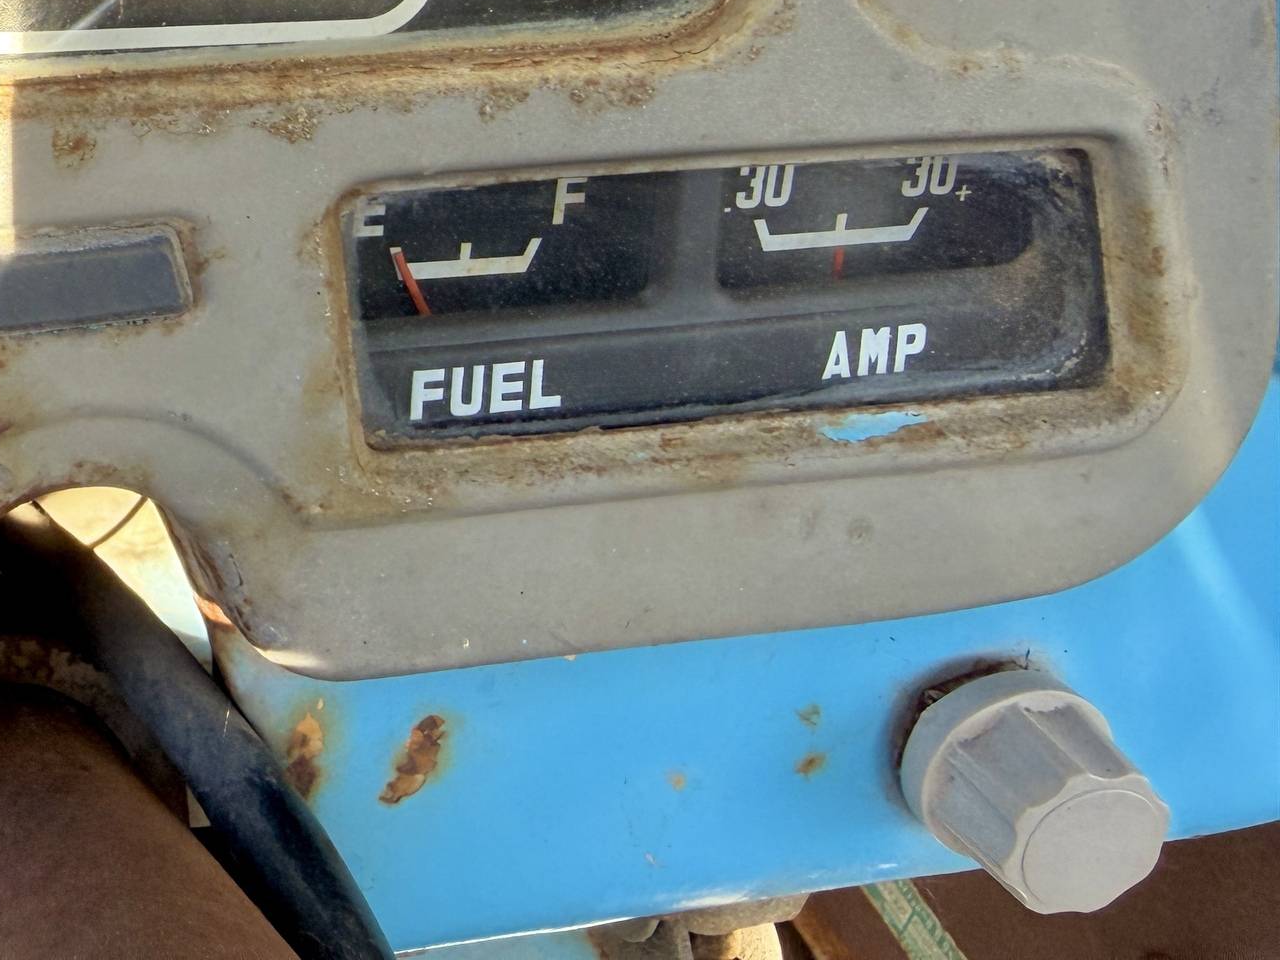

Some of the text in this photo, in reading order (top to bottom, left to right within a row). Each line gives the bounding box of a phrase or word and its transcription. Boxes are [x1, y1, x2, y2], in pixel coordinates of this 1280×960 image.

[552, 176, 589, 225] F
[821, 322, 928, 381] AMP
[409, 359, 562, 421] FUEL
